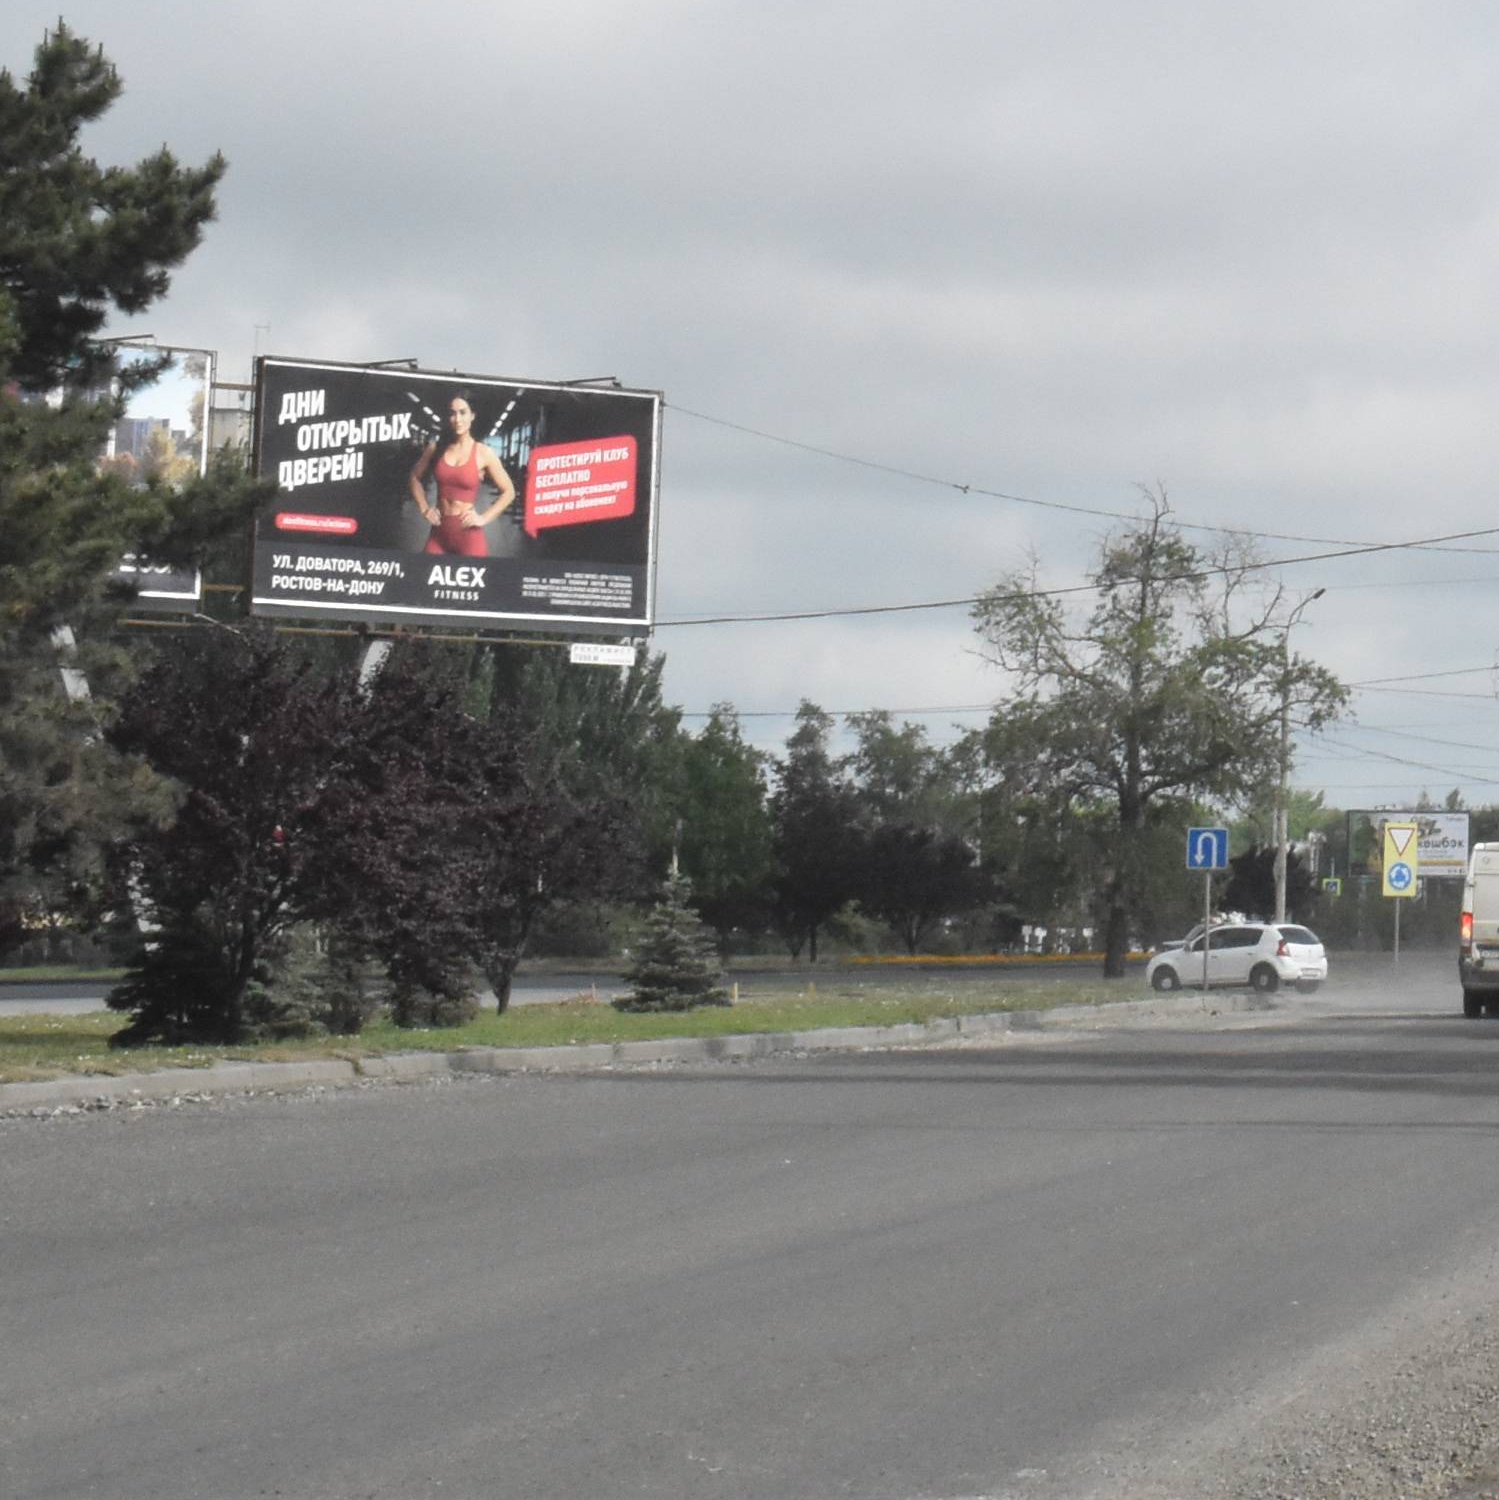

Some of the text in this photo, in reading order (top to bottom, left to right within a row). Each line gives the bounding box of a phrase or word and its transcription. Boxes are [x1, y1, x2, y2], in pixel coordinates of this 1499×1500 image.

[278, 389, 326, 426] ДНИ
[297, 412, 412, 452] ОТКРЫТЫХ
[279, 446, 364, 492] ДВЕРЕЙ!
[536, 446, 630, 472] ПРОТЕСТИРУЙ КЛУБ
[535, 469, 591, 489] БЕСПЛАТНО
[272, 554, 405, 578] УЛ. ДОВАТОРА, 269/1,
[428, 565, 486, 588] ALEX
[271, 575, 385, 596] РОСТОВ-НА-ДОНУ
[434, 589, 480, 601] FITNESS
